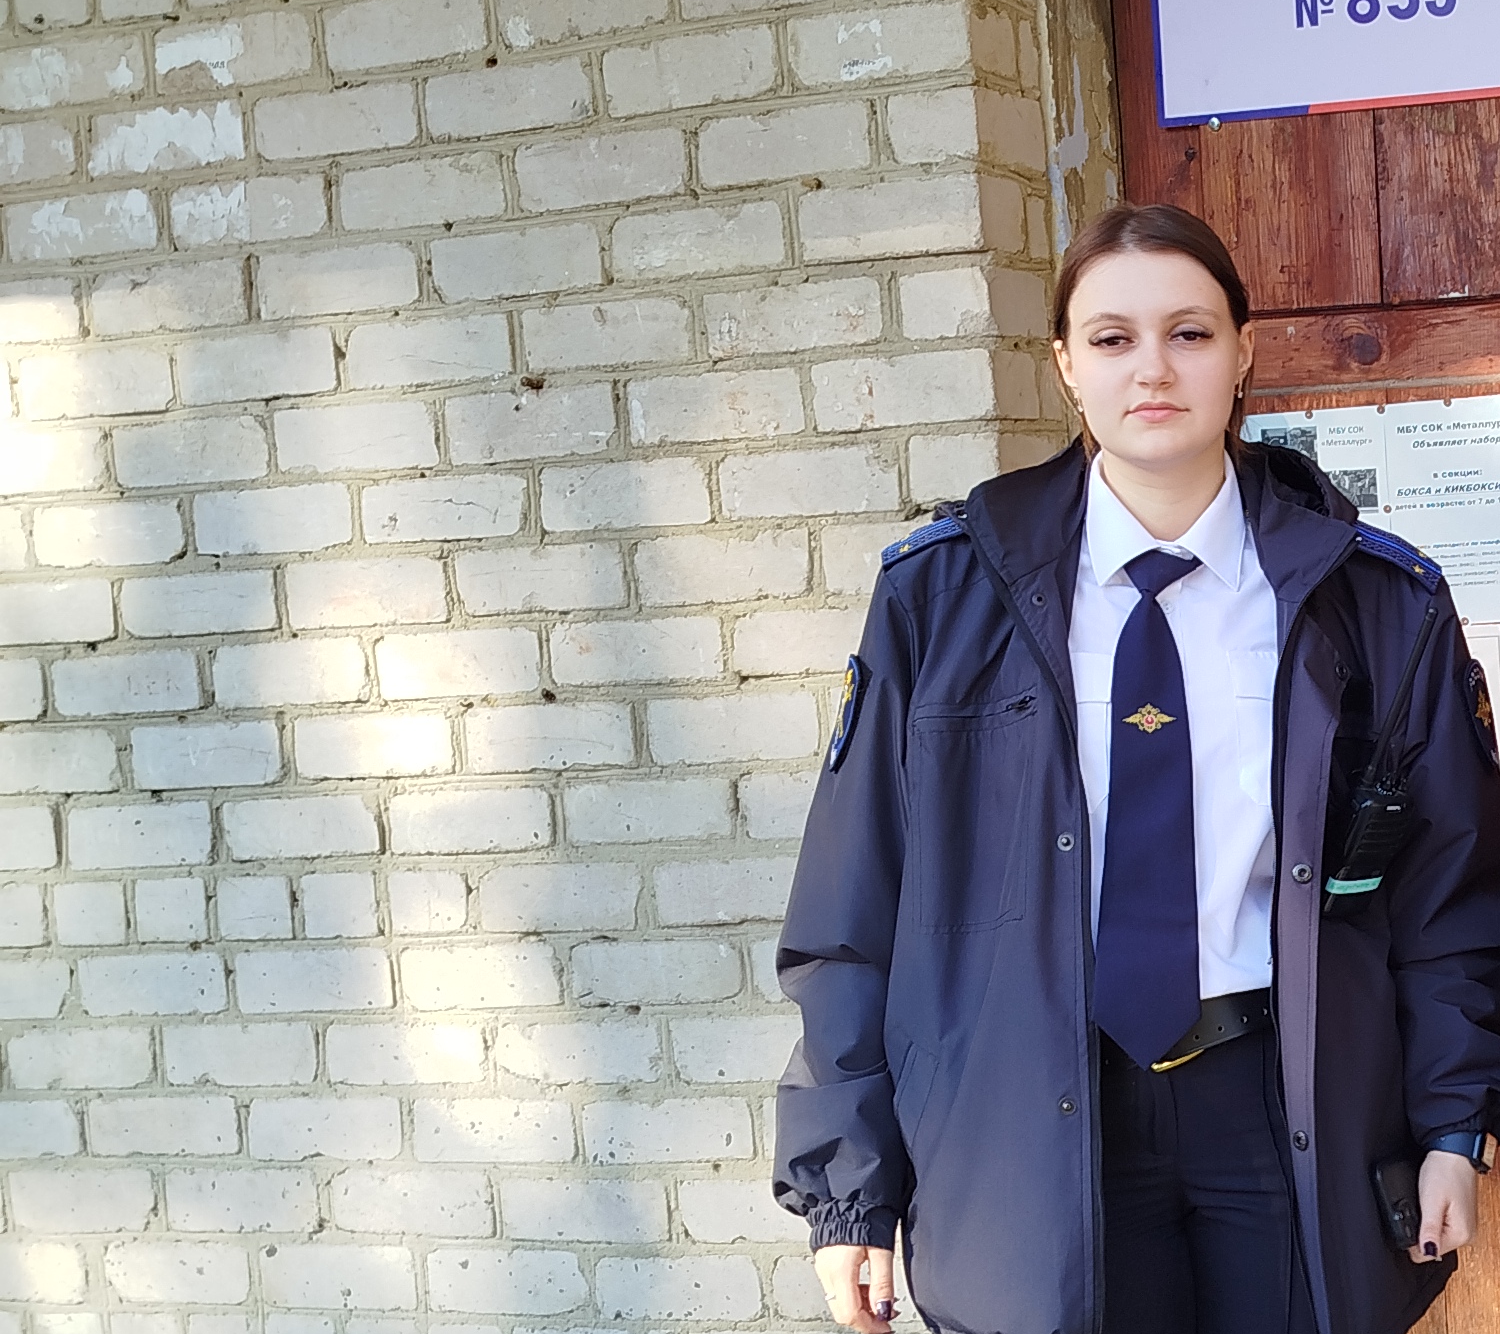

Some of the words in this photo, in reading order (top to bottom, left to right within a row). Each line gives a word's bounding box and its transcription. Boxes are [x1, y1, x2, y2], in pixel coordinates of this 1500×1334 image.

[1397, 425, 1418, 434] МБУ
[1421, 423, 1443, 433] СОК
[1412, 438, 1468, 449] Объявляет
[1441, 469, 1483, 479] секции:
[1396, 487, 1432, 497] БОКСА
